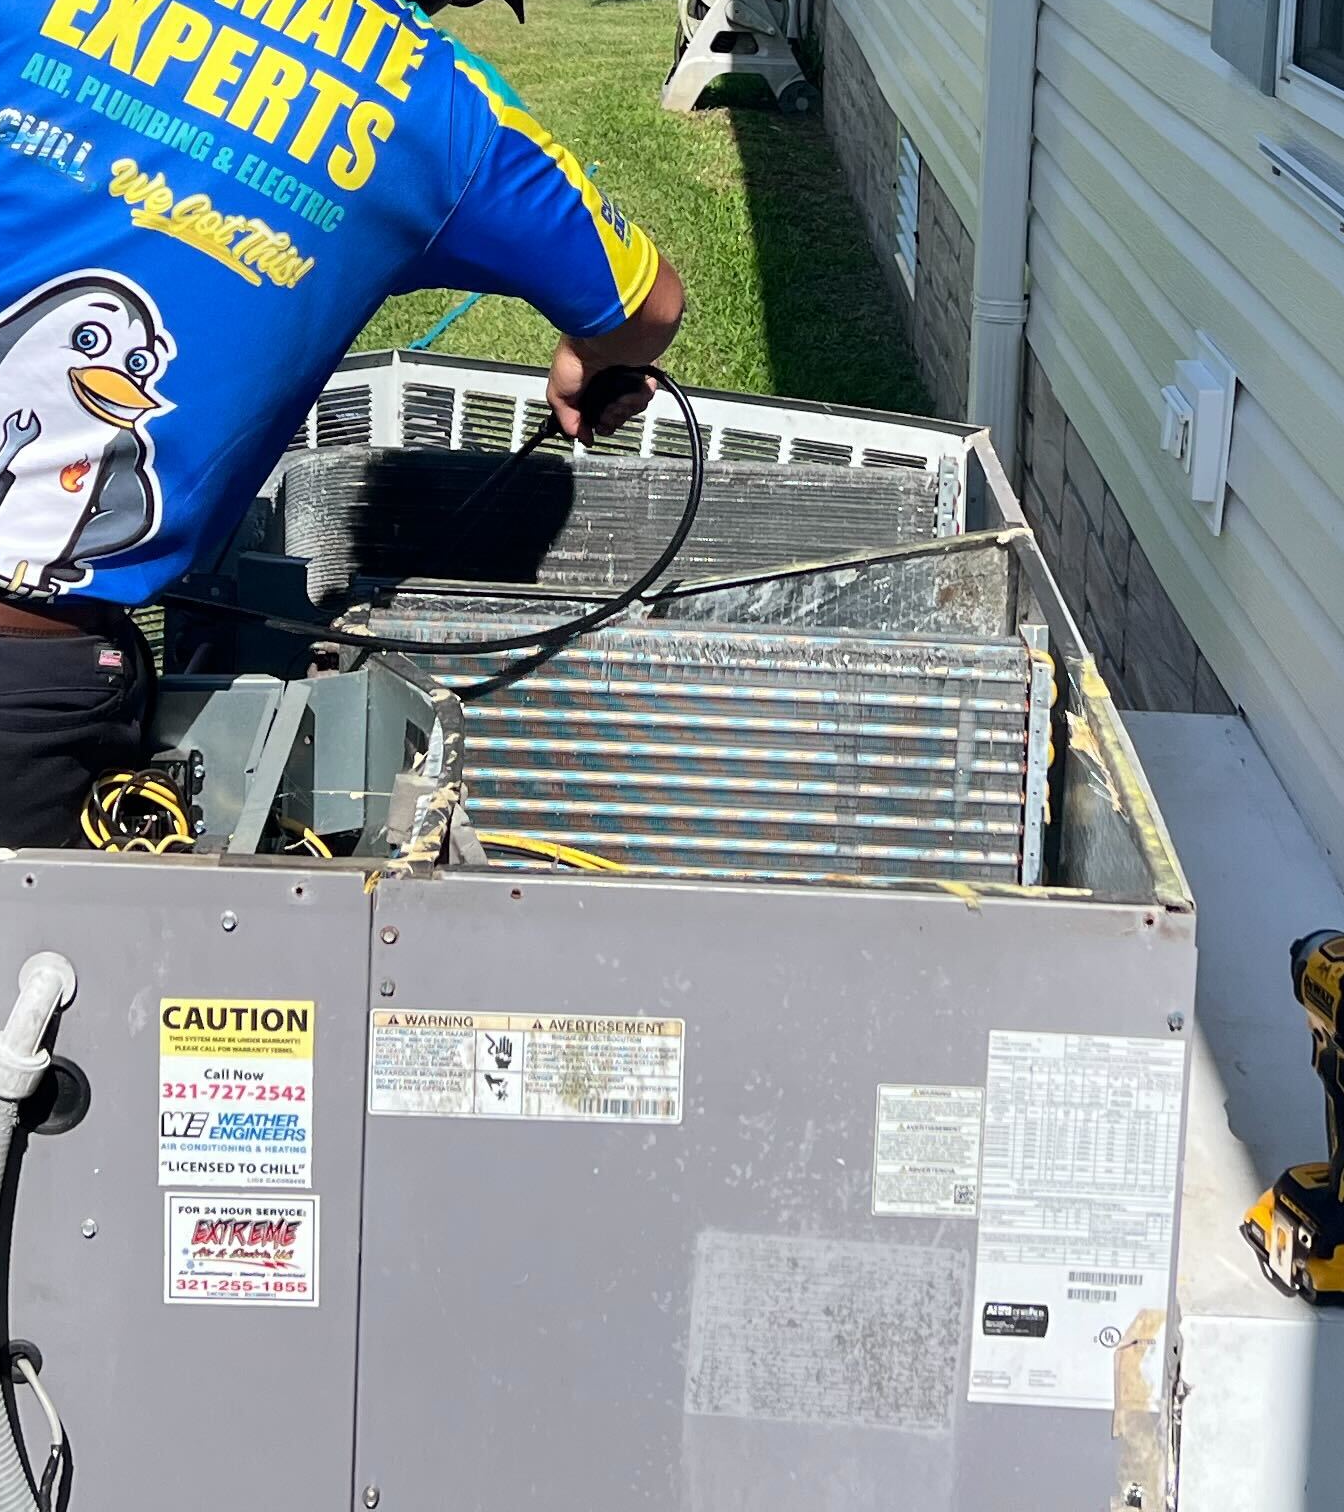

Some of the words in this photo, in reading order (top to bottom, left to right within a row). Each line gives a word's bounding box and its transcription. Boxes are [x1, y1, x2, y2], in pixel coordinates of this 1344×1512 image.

[20, 52, 73, 99] AIR,
[76, 75, 215, 163] PLUMBING
[212, 146, 234, 174] &
[235, 153, 345, 233] ELECTRIC
[109, 158, 173, 214] We
[171, 193, 246, 245] Got
[231, 218, 315, 289] This!
[162, 1005, 309, 1032] CAUTION
[405, 1014, 474, 1028] WARNING
[549, 1019, 665, 1034] AVERTISSEMENT
[204, 1068, 230, 1080] Call
[233, 1069, 264, 1081] Now
[162, 1083, 306, 1102] 321-727-2542
[161, 1111, 210, 1138] WE
[217, 1112, 299, 1128] WEATHER
[209, 1127, 306, 1141] ENGINEERS
[161, 1143, 177, 1151] AIR
[180, 1144, 252, 1153] CONDITIONING
[255, 1145, 262, 1153] &
[265, 1145, 307, 1154] HEATING
[161, 1161, 235, 1173] "LICENSED
[238, 1163, 256, 1174] TO
[260, 1163, 306, 1175] CHILL"
[178, 1206, 200, 1214] FOR
[205, 1207, 217, 1215] 24
[220, 1207, 252, 1215] HOUR
[256, 1207, 307, 1217] SERVICE:
[191, 1217, 303, 1249] EXTREME
[176, 1279, 307, 1293] 321-255-1855
